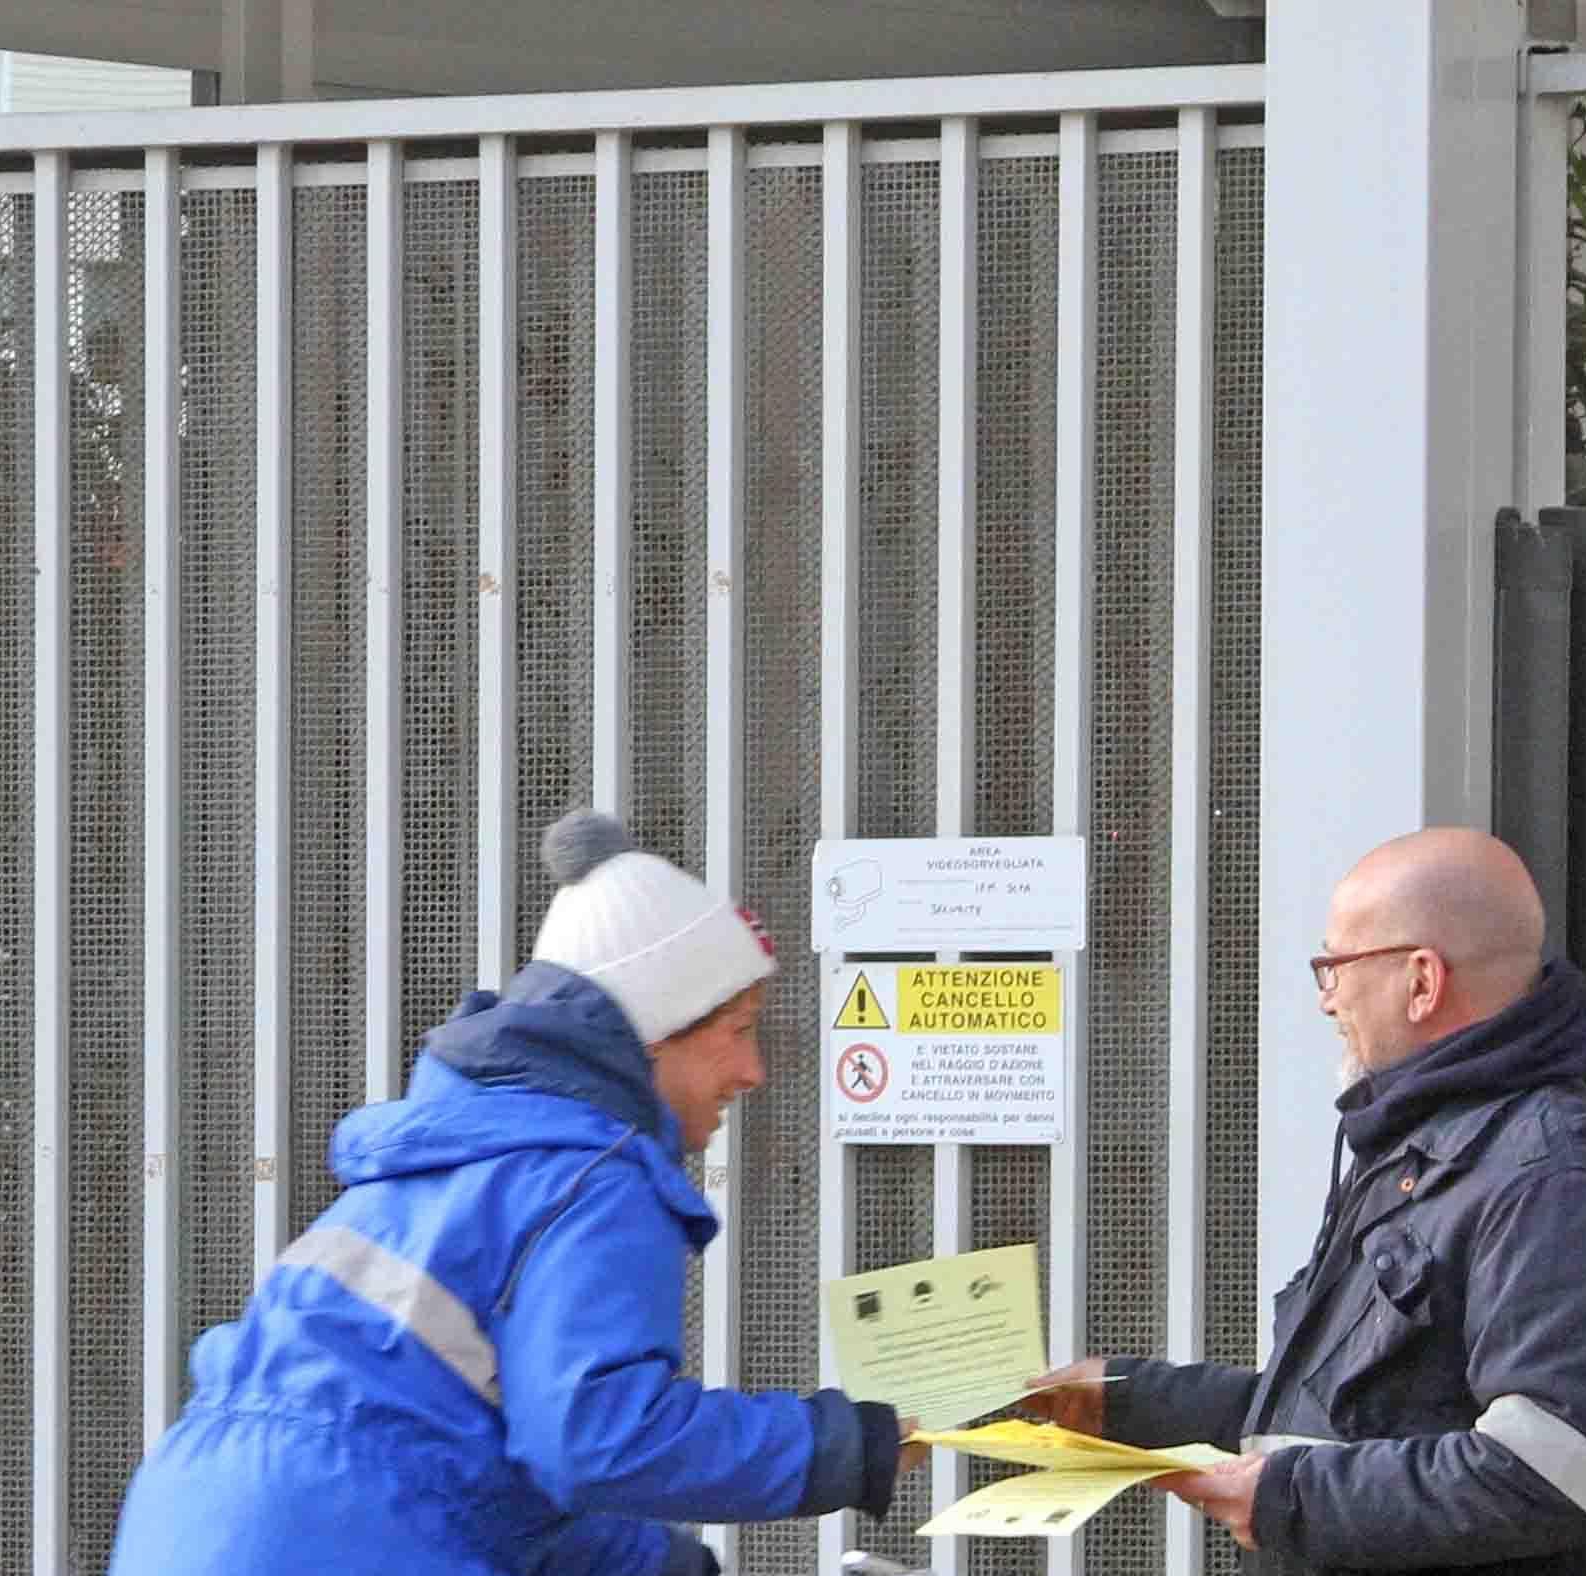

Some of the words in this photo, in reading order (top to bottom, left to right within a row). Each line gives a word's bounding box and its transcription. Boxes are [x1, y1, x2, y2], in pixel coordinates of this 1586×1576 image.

[912, 970, 1044, 987] ATTENZIONE
[920, 991, 1035, 1008] CANCELLO
[909, 1012, 1046, 1029] AUTOMATICO
[933, 1044, 980, 1056] VIETATO
[901, 1090, 964, 1101] CANCELLO
